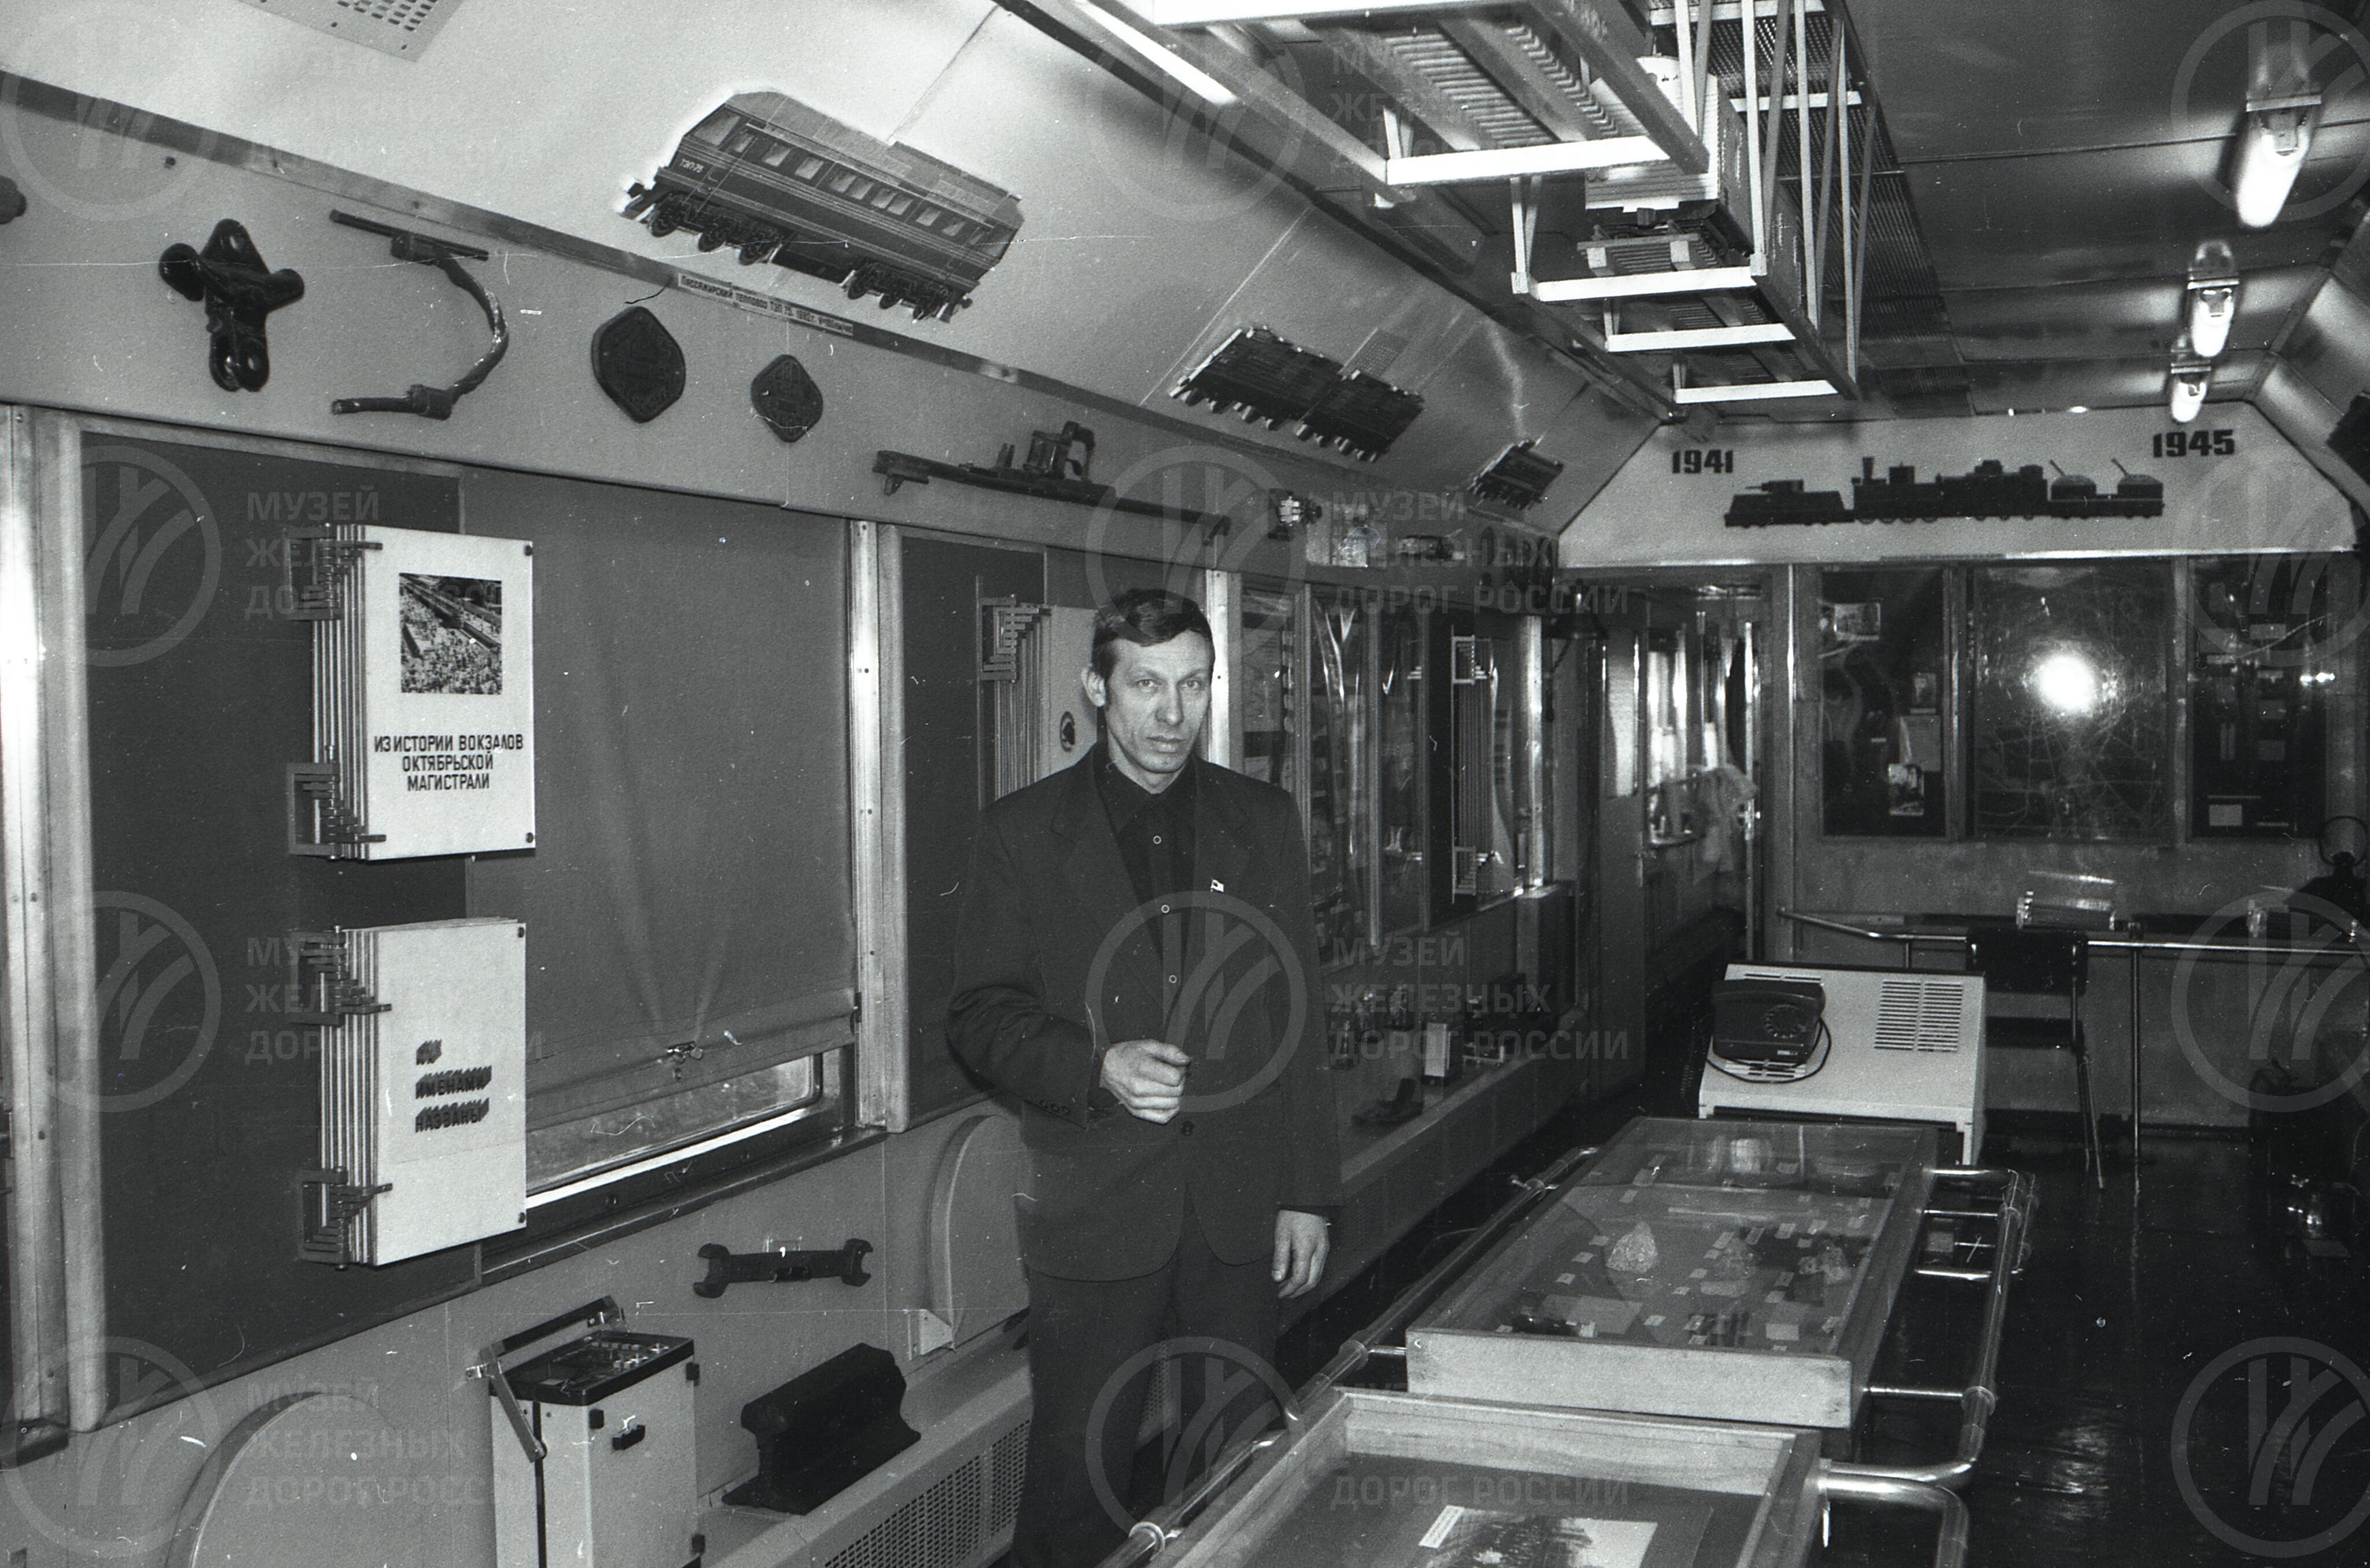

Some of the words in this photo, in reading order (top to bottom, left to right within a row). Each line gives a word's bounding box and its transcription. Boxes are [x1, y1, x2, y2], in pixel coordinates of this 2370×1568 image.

[2153, 429, 2235, 458] 1945
[1672, 449, 1734, 474] 1941
[374, 735, 391, 752] ИЗ
[393, 735, 454, 752] ИСТОРИИ
[458, 734, 524, 750] ВОКЗАЛОВ
[403, 751, 494, 772] ОКТЯБРЬСКОЙ
[407, 773, 490, 792] МАГИСТРАЛИ
[415, 1065, 492, 1099] ИМЕНАМИ
[415, 1097, 490, 1133] НАЗВАНЫ
